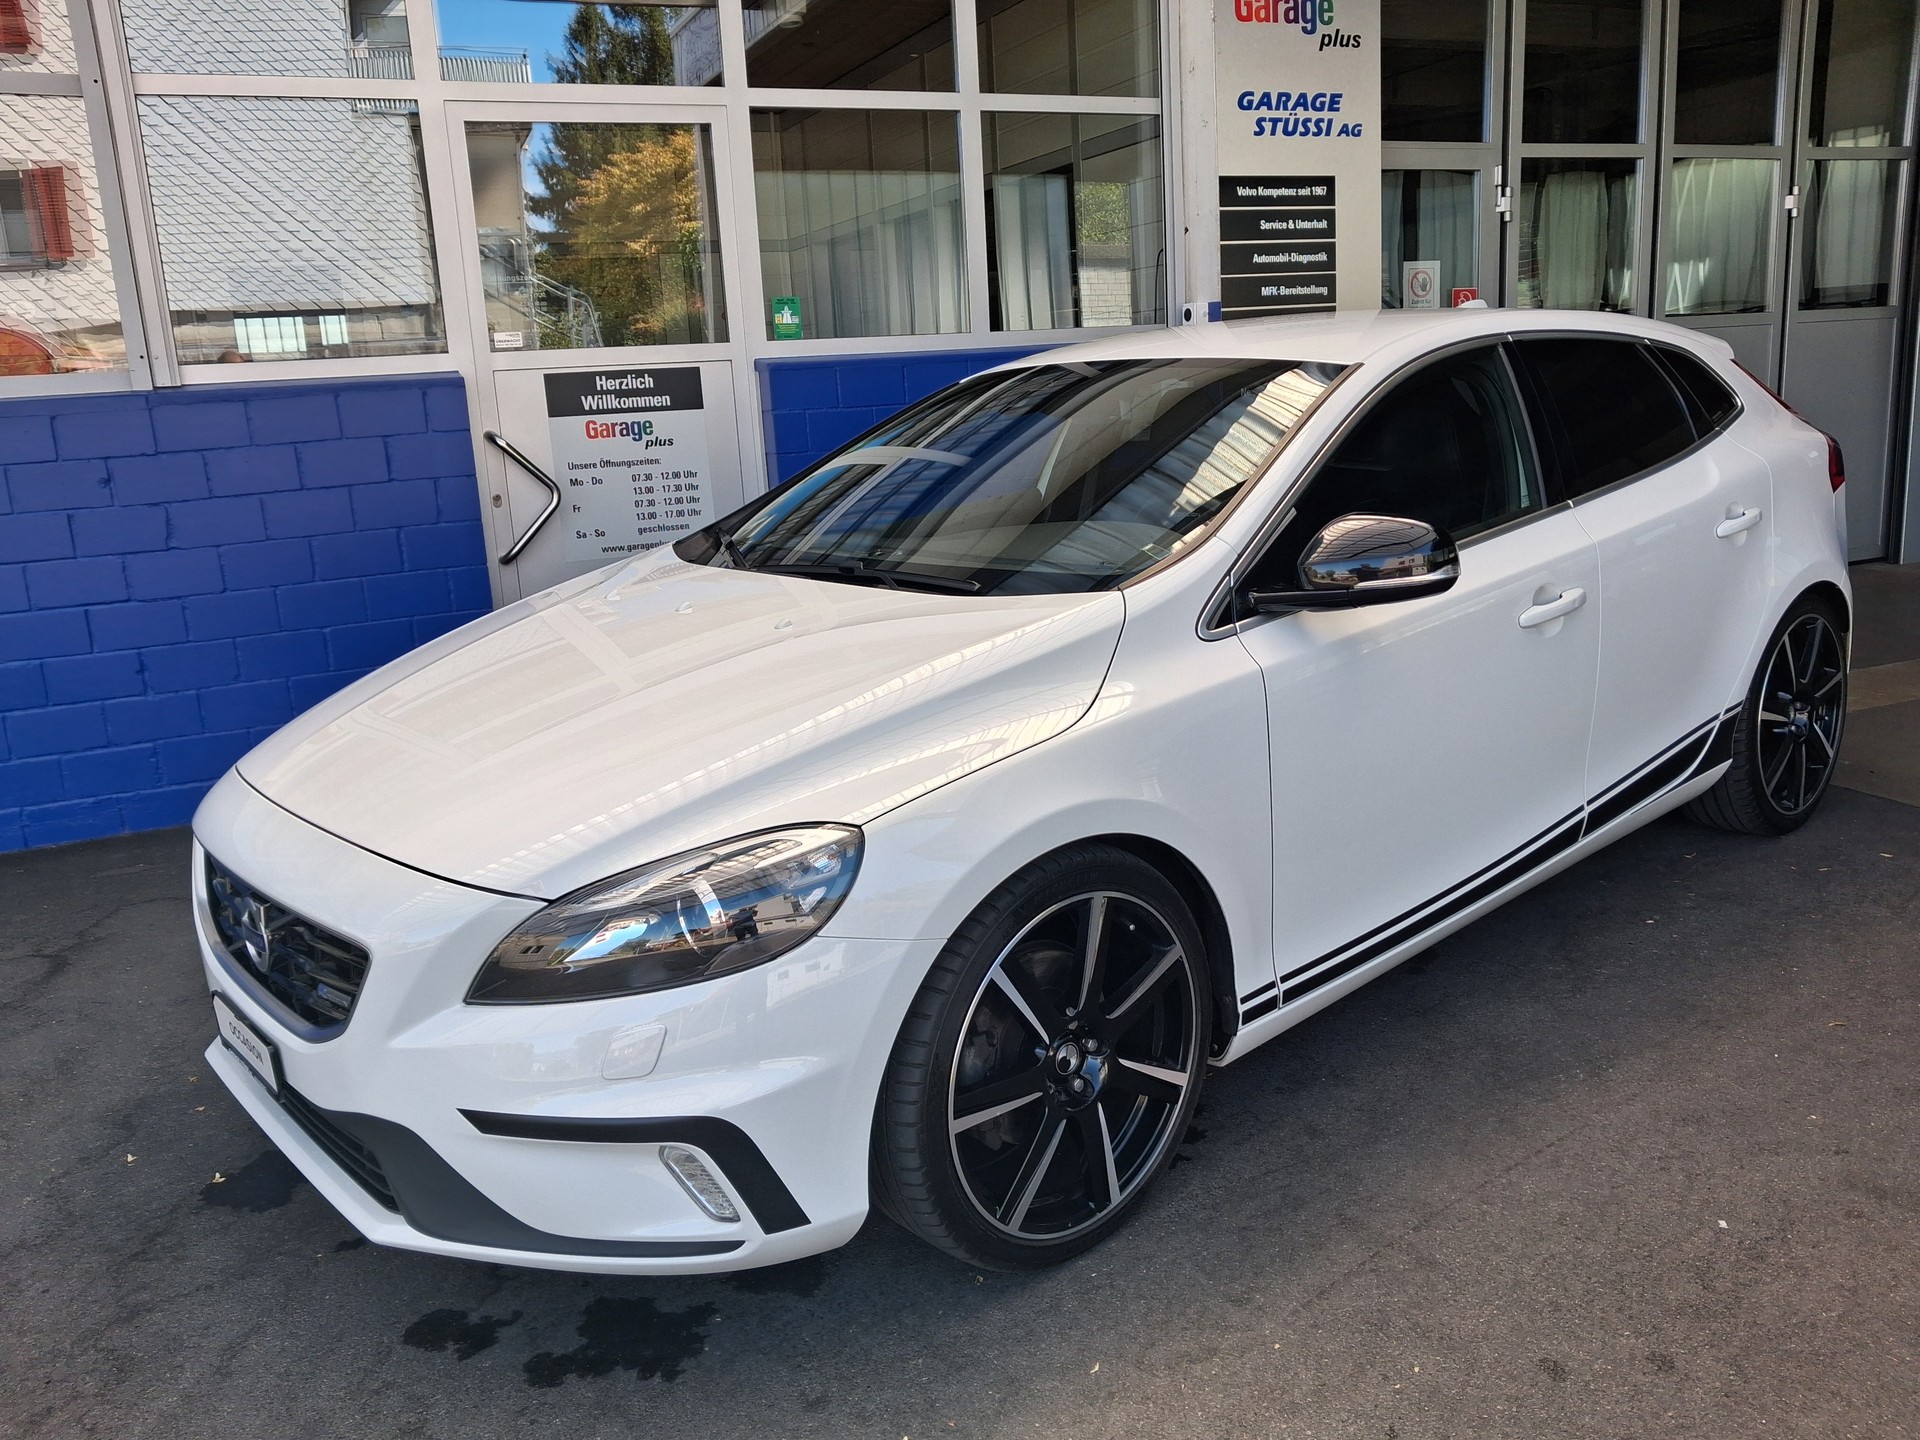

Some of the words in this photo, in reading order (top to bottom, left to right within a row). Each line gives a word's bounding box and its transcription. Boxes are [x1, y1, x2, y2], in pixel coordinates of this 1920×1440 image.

[1235, 0, 1334, 35] Garage
[1319, 29, 1361, 51] plus
[1237, 90, 1343, 112] GARAGE
[1253, 113, 1333, 137] STÜSSI
[1336, 122, 1362, 138] AG
[1237, 186, 1257, 197] Volvo
[1257, 186, 1296, 199] Kompetenz
[1297, 186, 1311, 196] seit
[1311, 186, 1327, 196] 1967
[1260, 220, 1287, 230] Service
[1288, 220, 1295, 230] &
[1296, 219, 1327, 230] Unterhalt
[1253, 252, 1327, 264] Automobil-Diagnostik
[1261, 285, 1328, 297] MFK-Bereitstellung
[596, 374, 654, 391] Herzlich
[581, 393, 671, 411] Willkommen
[586, 419, 654, 441] Garage
[645, 436, 674, 450] plus
[567, 461, 598, 471] Unsere
[599, 457, 662, 469] Öffnungszeiten:
[569, 478, 584, 487] Mo
[591, 476, 604, 486] Do
[631, 473, 653, 483] 07.30
[661, 471, 682, 481] 12.00
[683, 469, 698, 479] Uhr
[633, 485, 655, 495] 13.00
[662, 484, 683, 494] 17.30
[684, 482, 700, 492] Uhr
[634, 499, 656, 508] 07.30
[663, 496, 684, 506] 12.00
[685, 495, 701, 505] Uhr
[572, 504, 582, 513] Fr
[636, 511, 657, 521] 13.00
[664, 509, 685, 519] 17.00
[687, 508, 702, 517] Uhr
[576, 530, 587, 539] Sa
[594, 529, 606, 538] So
[637, 523, 690, 536] geschlossen
[228, 1020, 264, 1065] OCCASION
